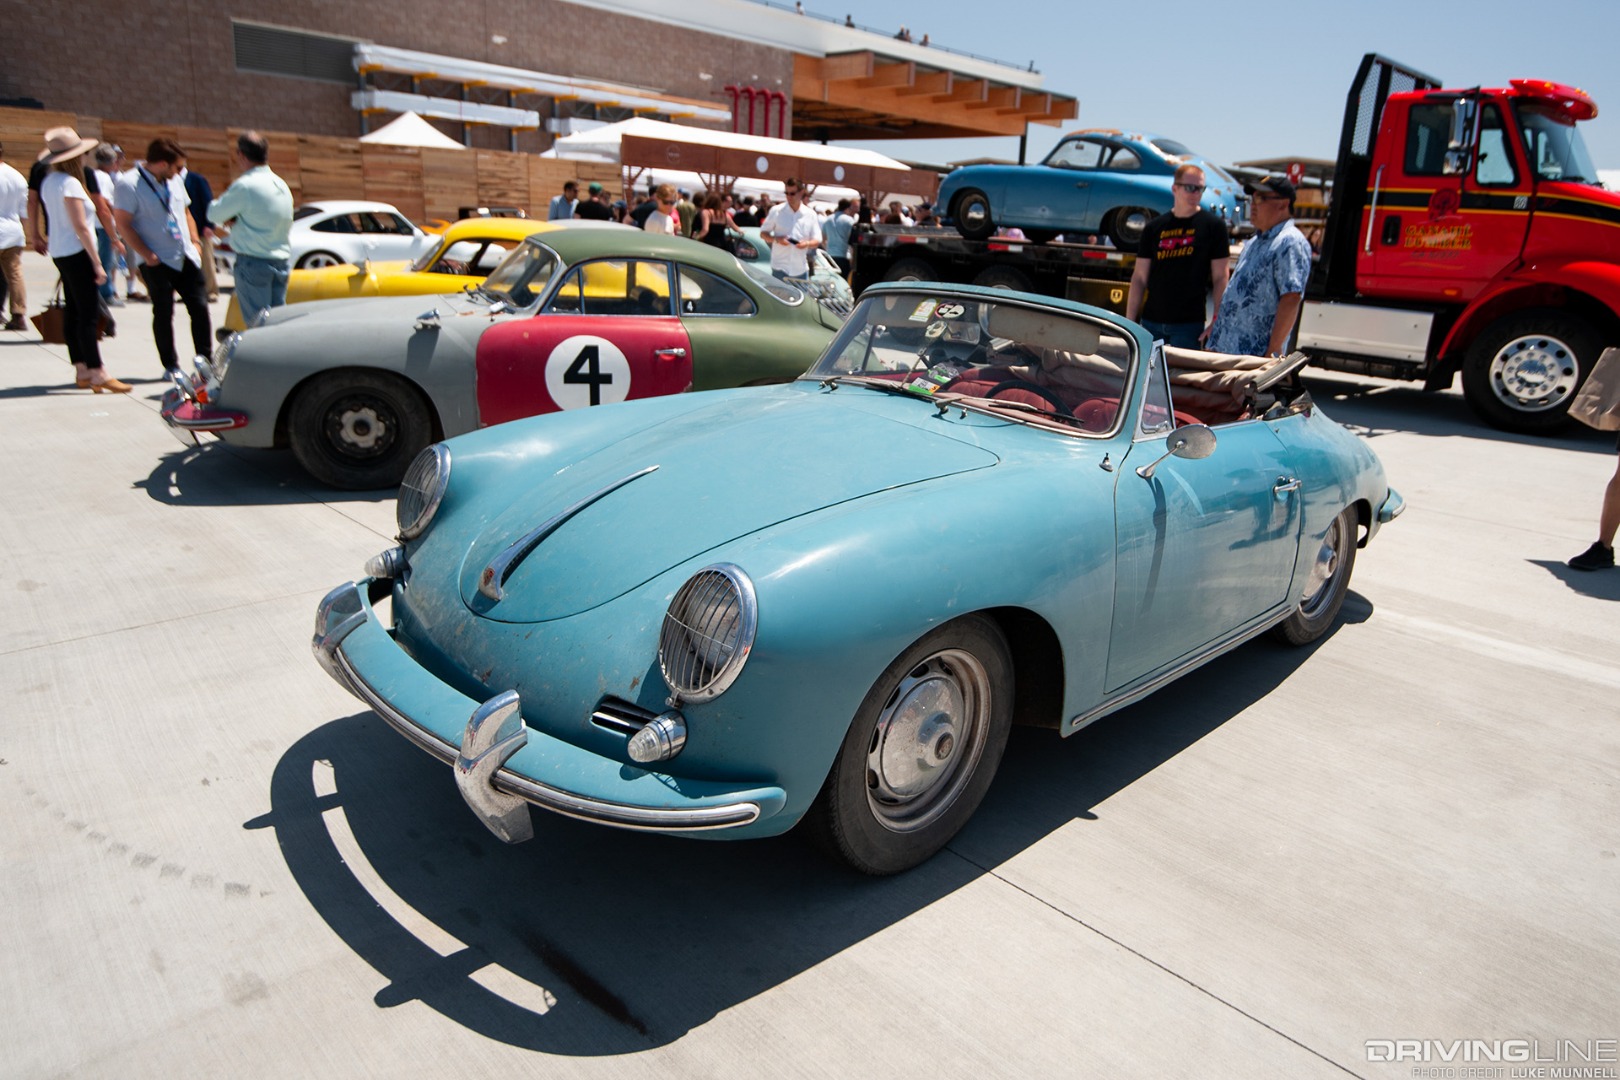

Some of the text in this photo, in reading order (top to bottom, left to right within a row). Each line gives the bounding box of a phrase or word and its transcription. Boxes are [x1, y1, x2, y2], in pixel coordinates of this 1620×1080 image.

[1404, 236, 1471, 250] LUMBER
[1157, 246, 1194, 260] POLISHED
[687, 301, 693, 311] 4
[563, 345, 613, 406] 4
